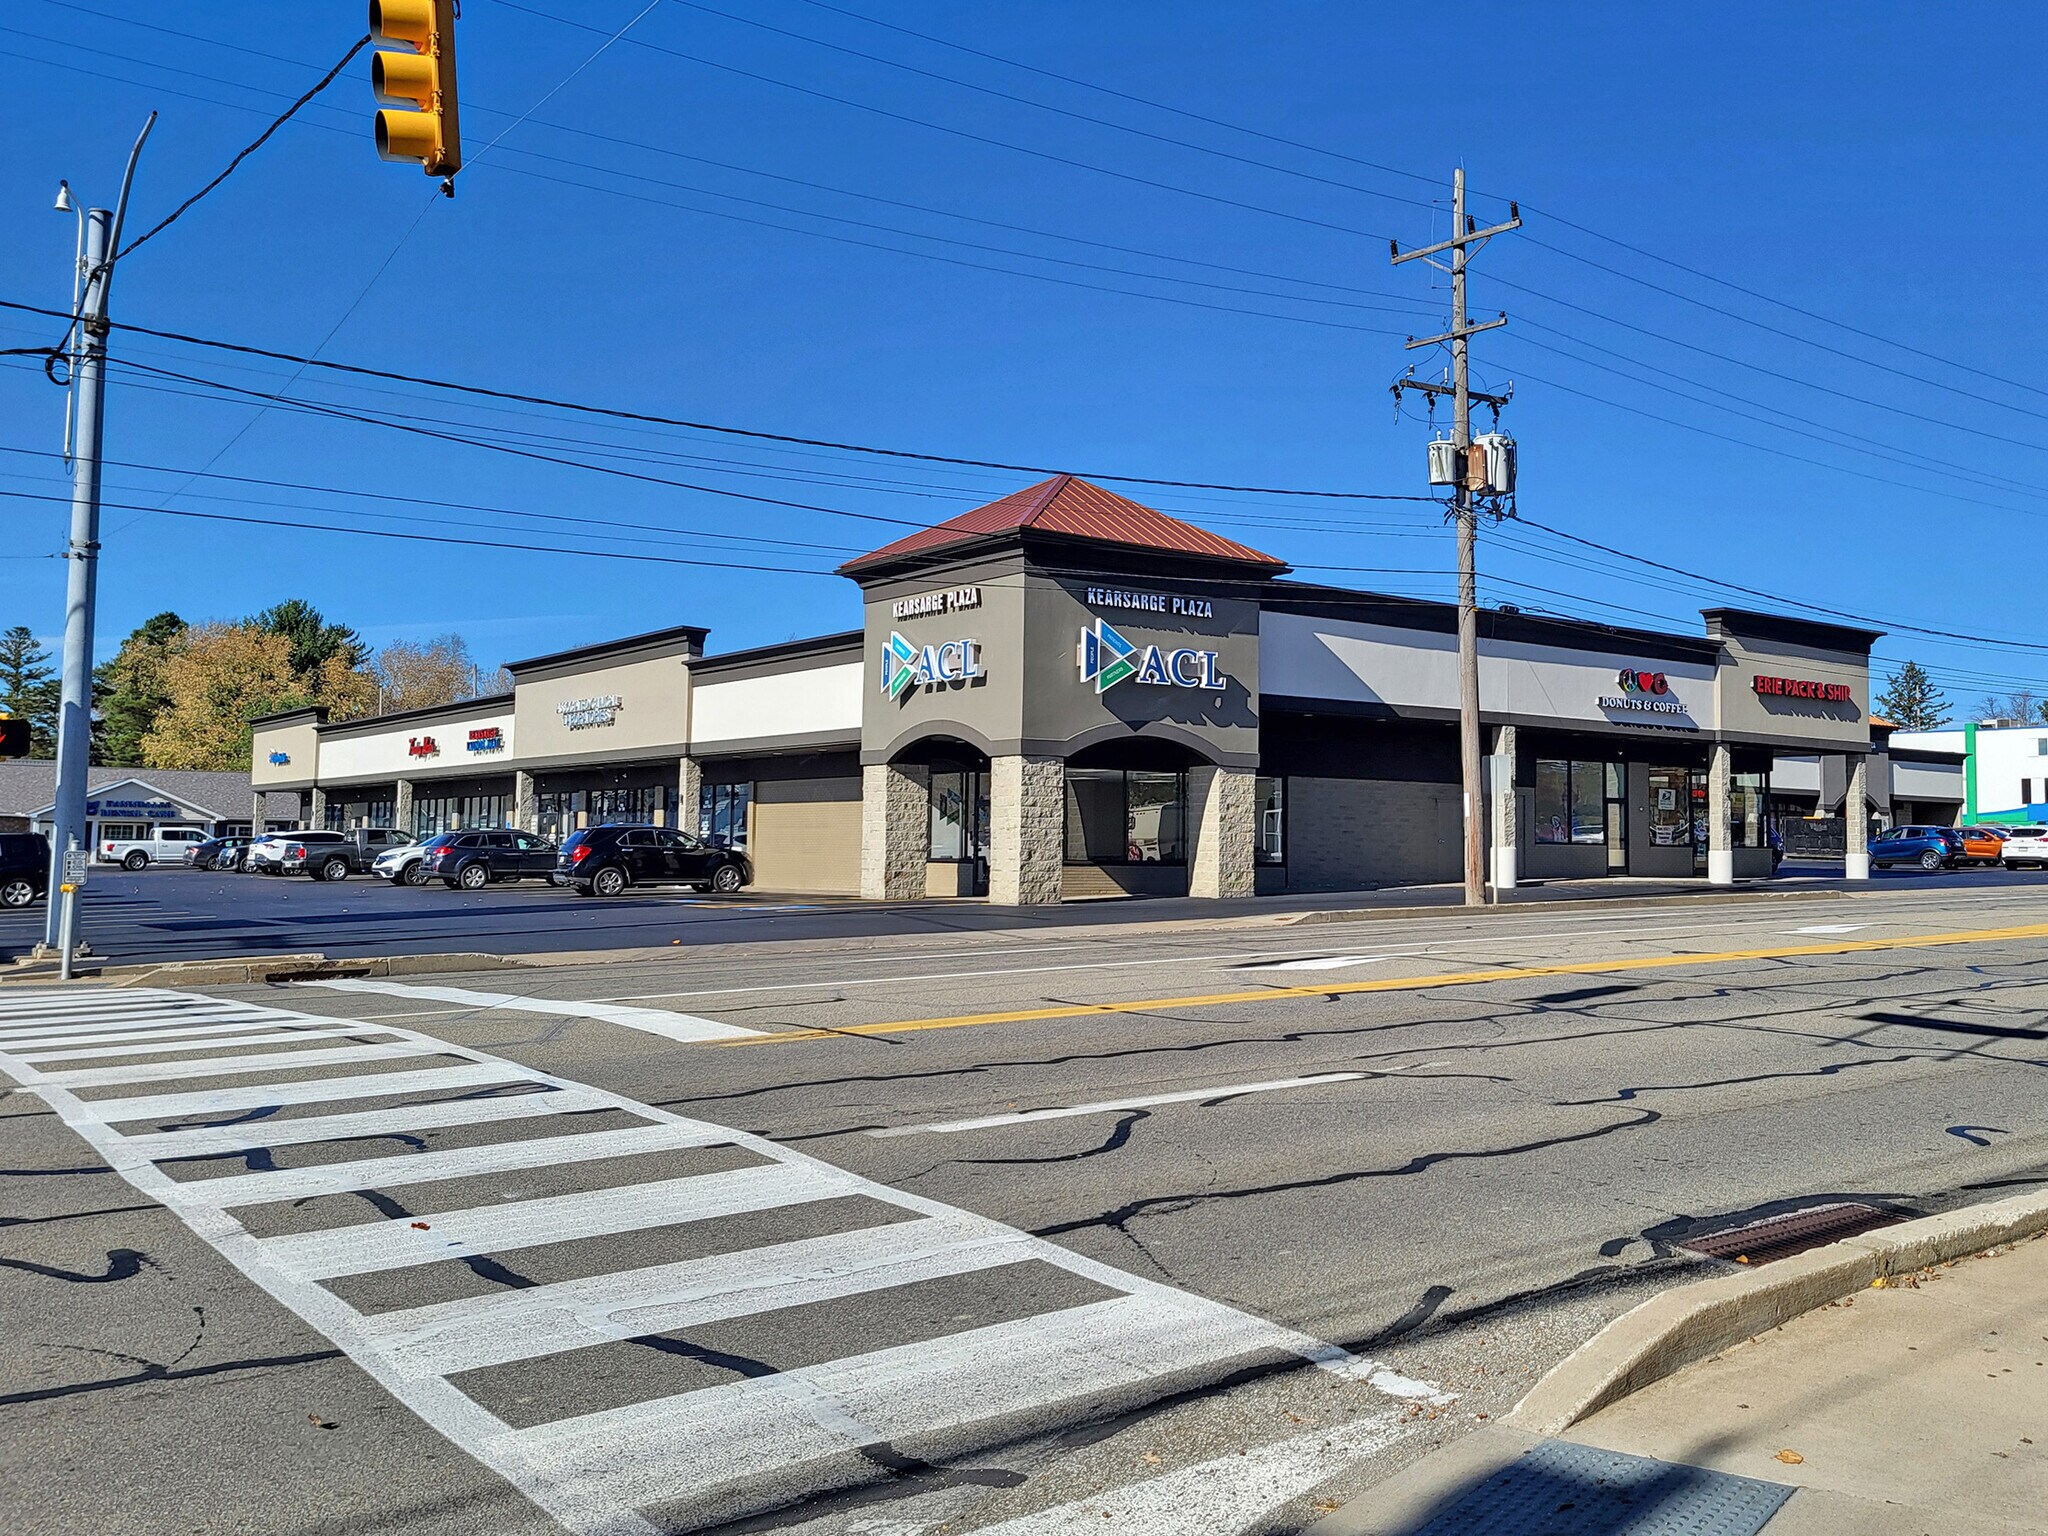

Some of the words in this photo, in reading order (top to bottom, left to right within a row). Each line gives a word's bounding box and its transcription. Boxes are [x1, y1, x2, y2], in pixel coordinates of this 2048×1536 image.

[893, 593, 944, 618] KEARSARGE
[946, 587, 977, 608] PLAZA
[1087, 587, 1166, 612] KEARSARGE
[1172, 597, 1213, 618] PLAZA
[914, 639, 981, 685] ACL
[1136, 645, 1227, 690] ACL
[1756, 677, 1783, 695] ERIE
[1785, 679, 1815, 699] PACK
[1816, 682, 1826, 699] &
[1827, 683, 1851, 702] SHIP
[1602, 697, 1643, 710] DONUTS
[1643, 700, 1653, 711] &
[1653, 701, 1689, 714] COFFEE
